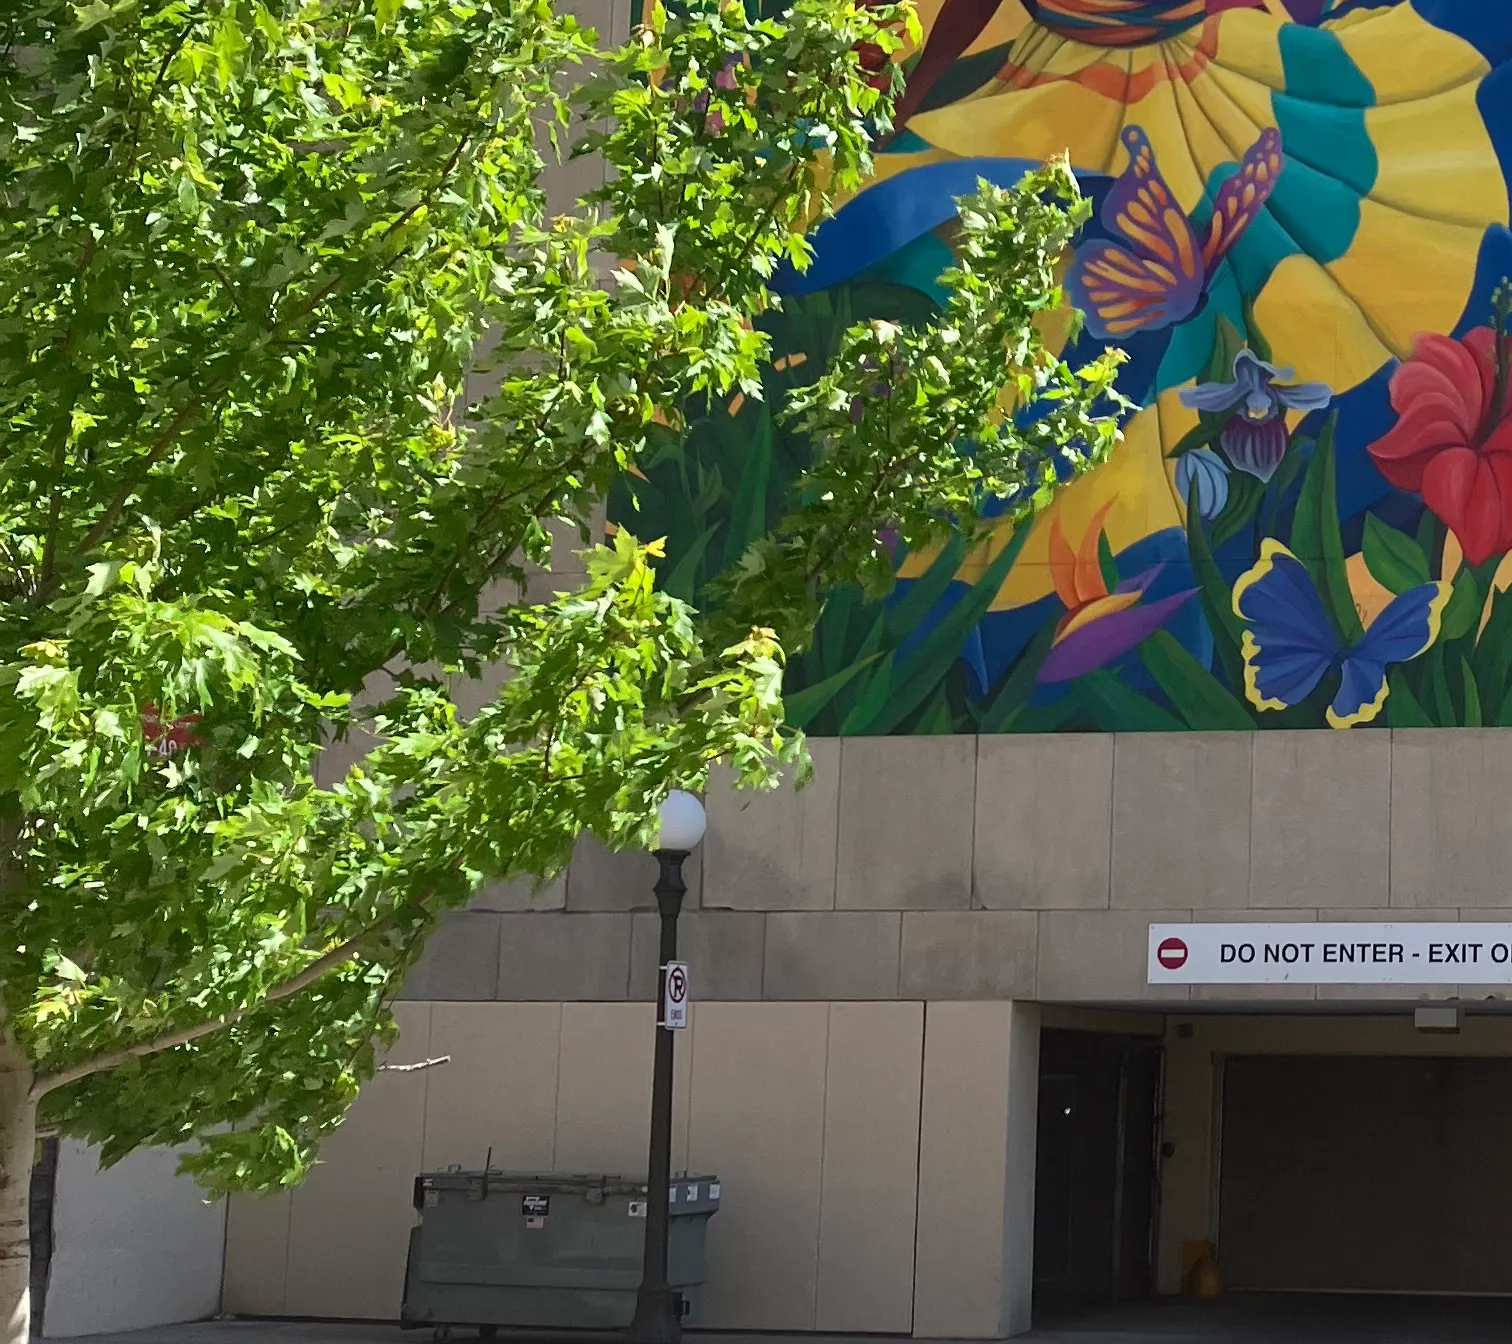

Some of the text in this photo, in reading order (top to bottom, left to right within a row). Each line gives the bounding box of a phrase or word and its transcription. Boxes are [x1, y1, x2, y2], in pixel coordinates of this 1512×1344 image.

[1220, 943, 1256, 963] DO
[1264, 943, 1316, 963] NOT
[1323, 943, 1404, 963] ENTER
[1429, 943, 1484, 963] EXIT
